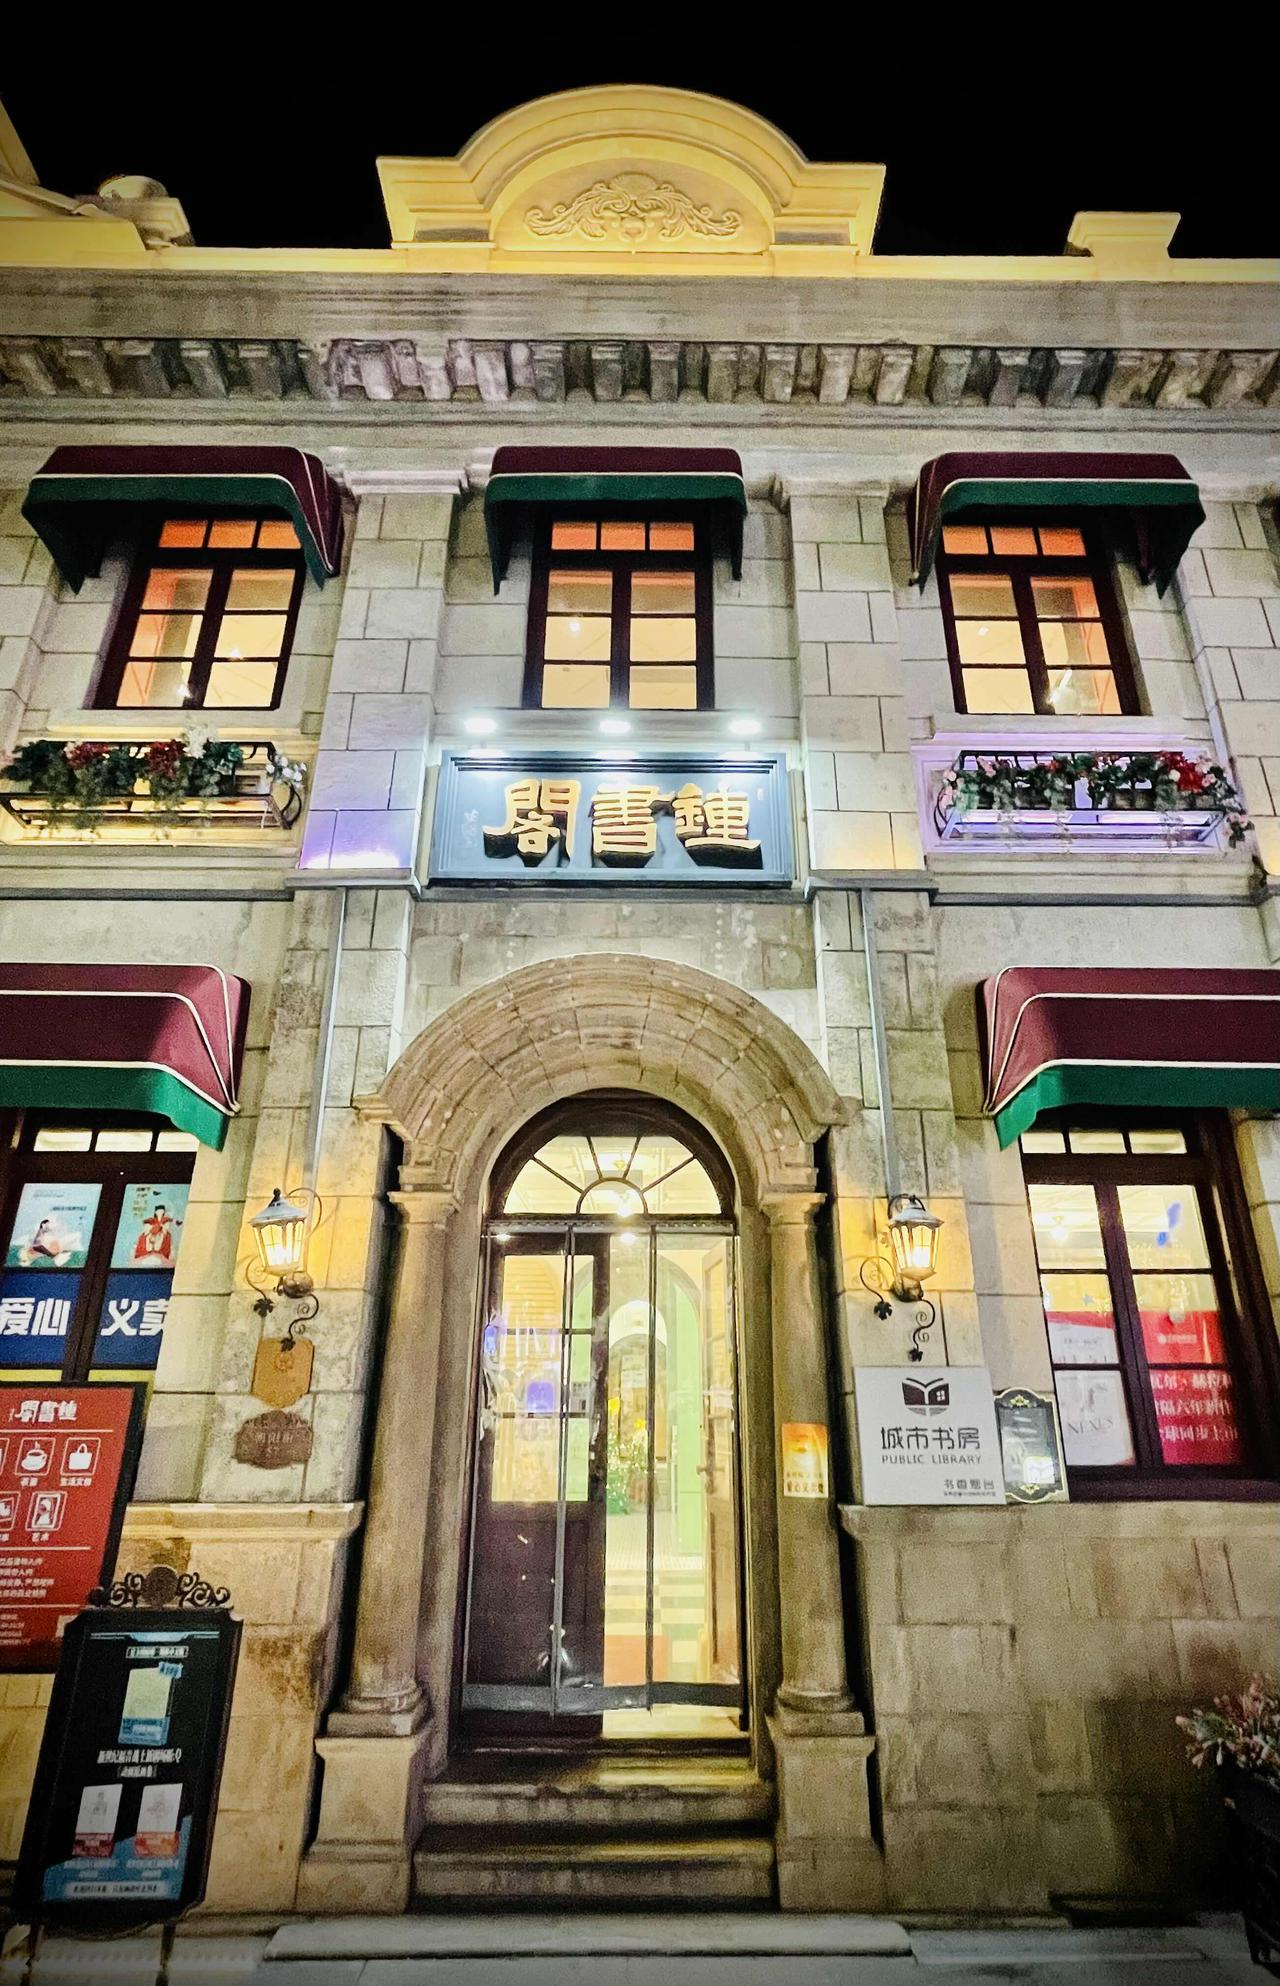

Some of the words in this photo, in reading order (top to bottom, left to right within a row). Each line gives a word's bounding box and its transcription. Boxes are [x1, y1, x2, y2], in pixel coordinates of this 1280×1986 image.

[880, 1426, 981, 1450] 城市书房
[881, 1454, 926, 1465] PUBLIC
[931, 1454, 982, 1465] LIBRARY
